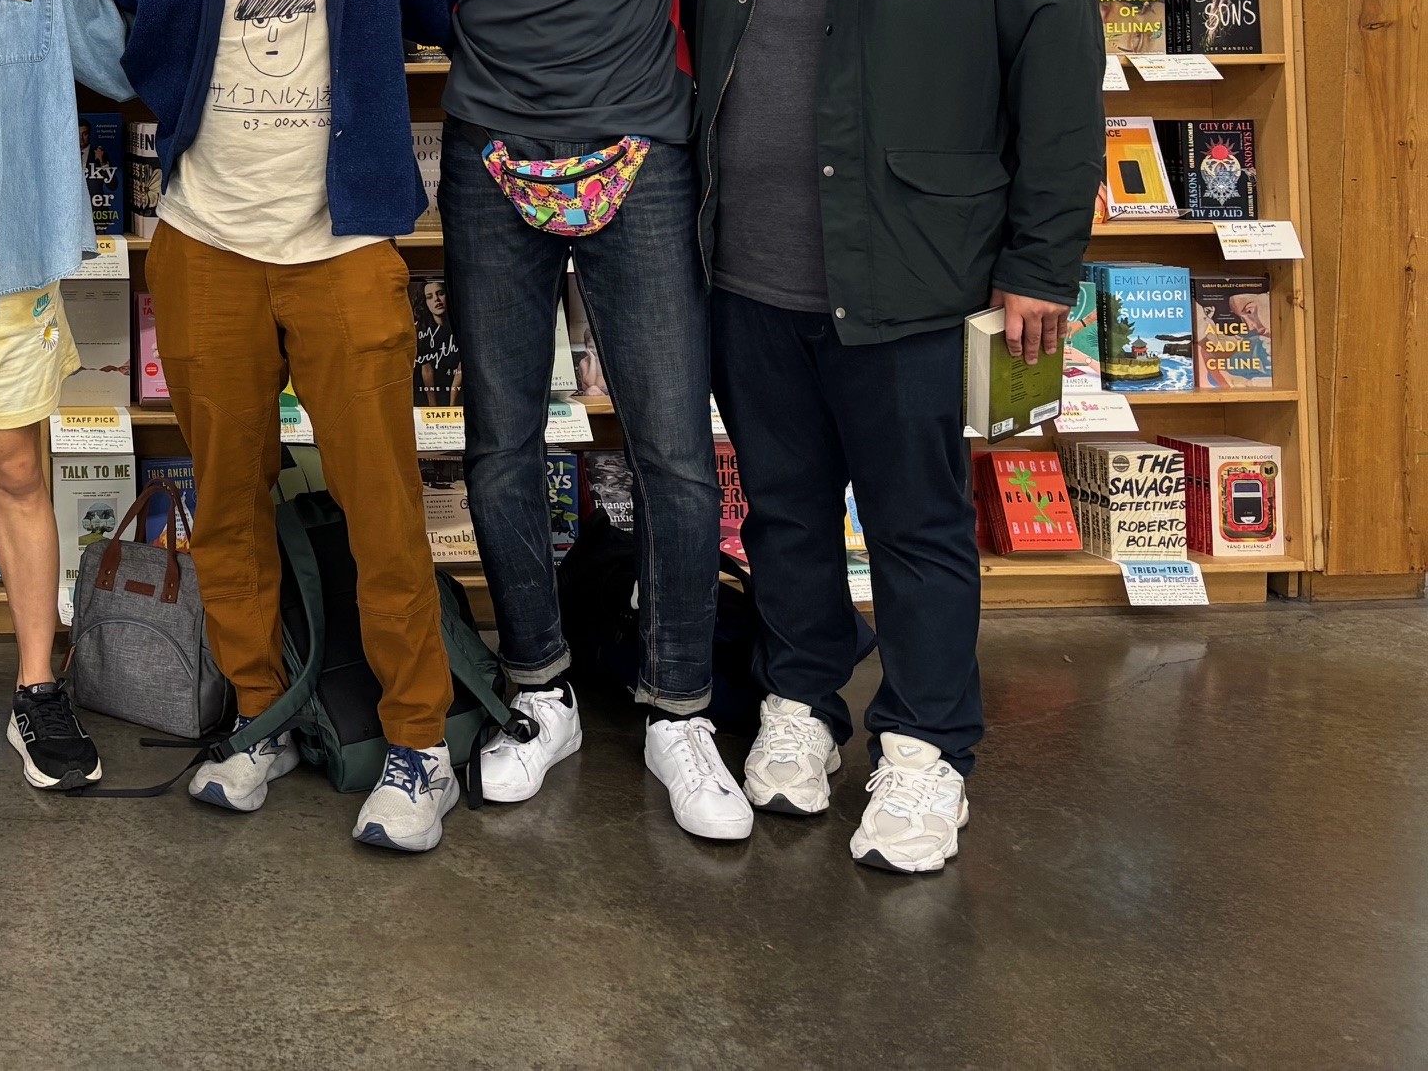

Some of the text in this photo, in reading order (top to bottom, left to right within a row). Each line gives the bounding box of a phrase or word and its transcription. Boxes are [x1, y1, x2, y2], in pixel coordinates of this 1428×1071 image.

[1120, 7, 1139, 17] OF
[1205, 1, 1255, 30] SONS
[1114, 291, 1187, 301] KAKIGORI
[1121, 308, 1183, 318] SUMMER
[1205, 323, 1248, 334] ALICE
[1207, 358, 1260, 370] CELINE
[90, 415, 115, 423] PICK
[1138, 455, 1185, 472] THE
[61, 464, 130, 479] TALK TO ME
[1108, 476, 1186, 498] SAVAGE
[1006, 492, 1063, 503] NEVADA
[1110, 499, 1186, 513] DETECTIVES
[1118, 518, 1187, 534] ROBERTO
[1126, 532, 1187, 548] BOLAÑO
